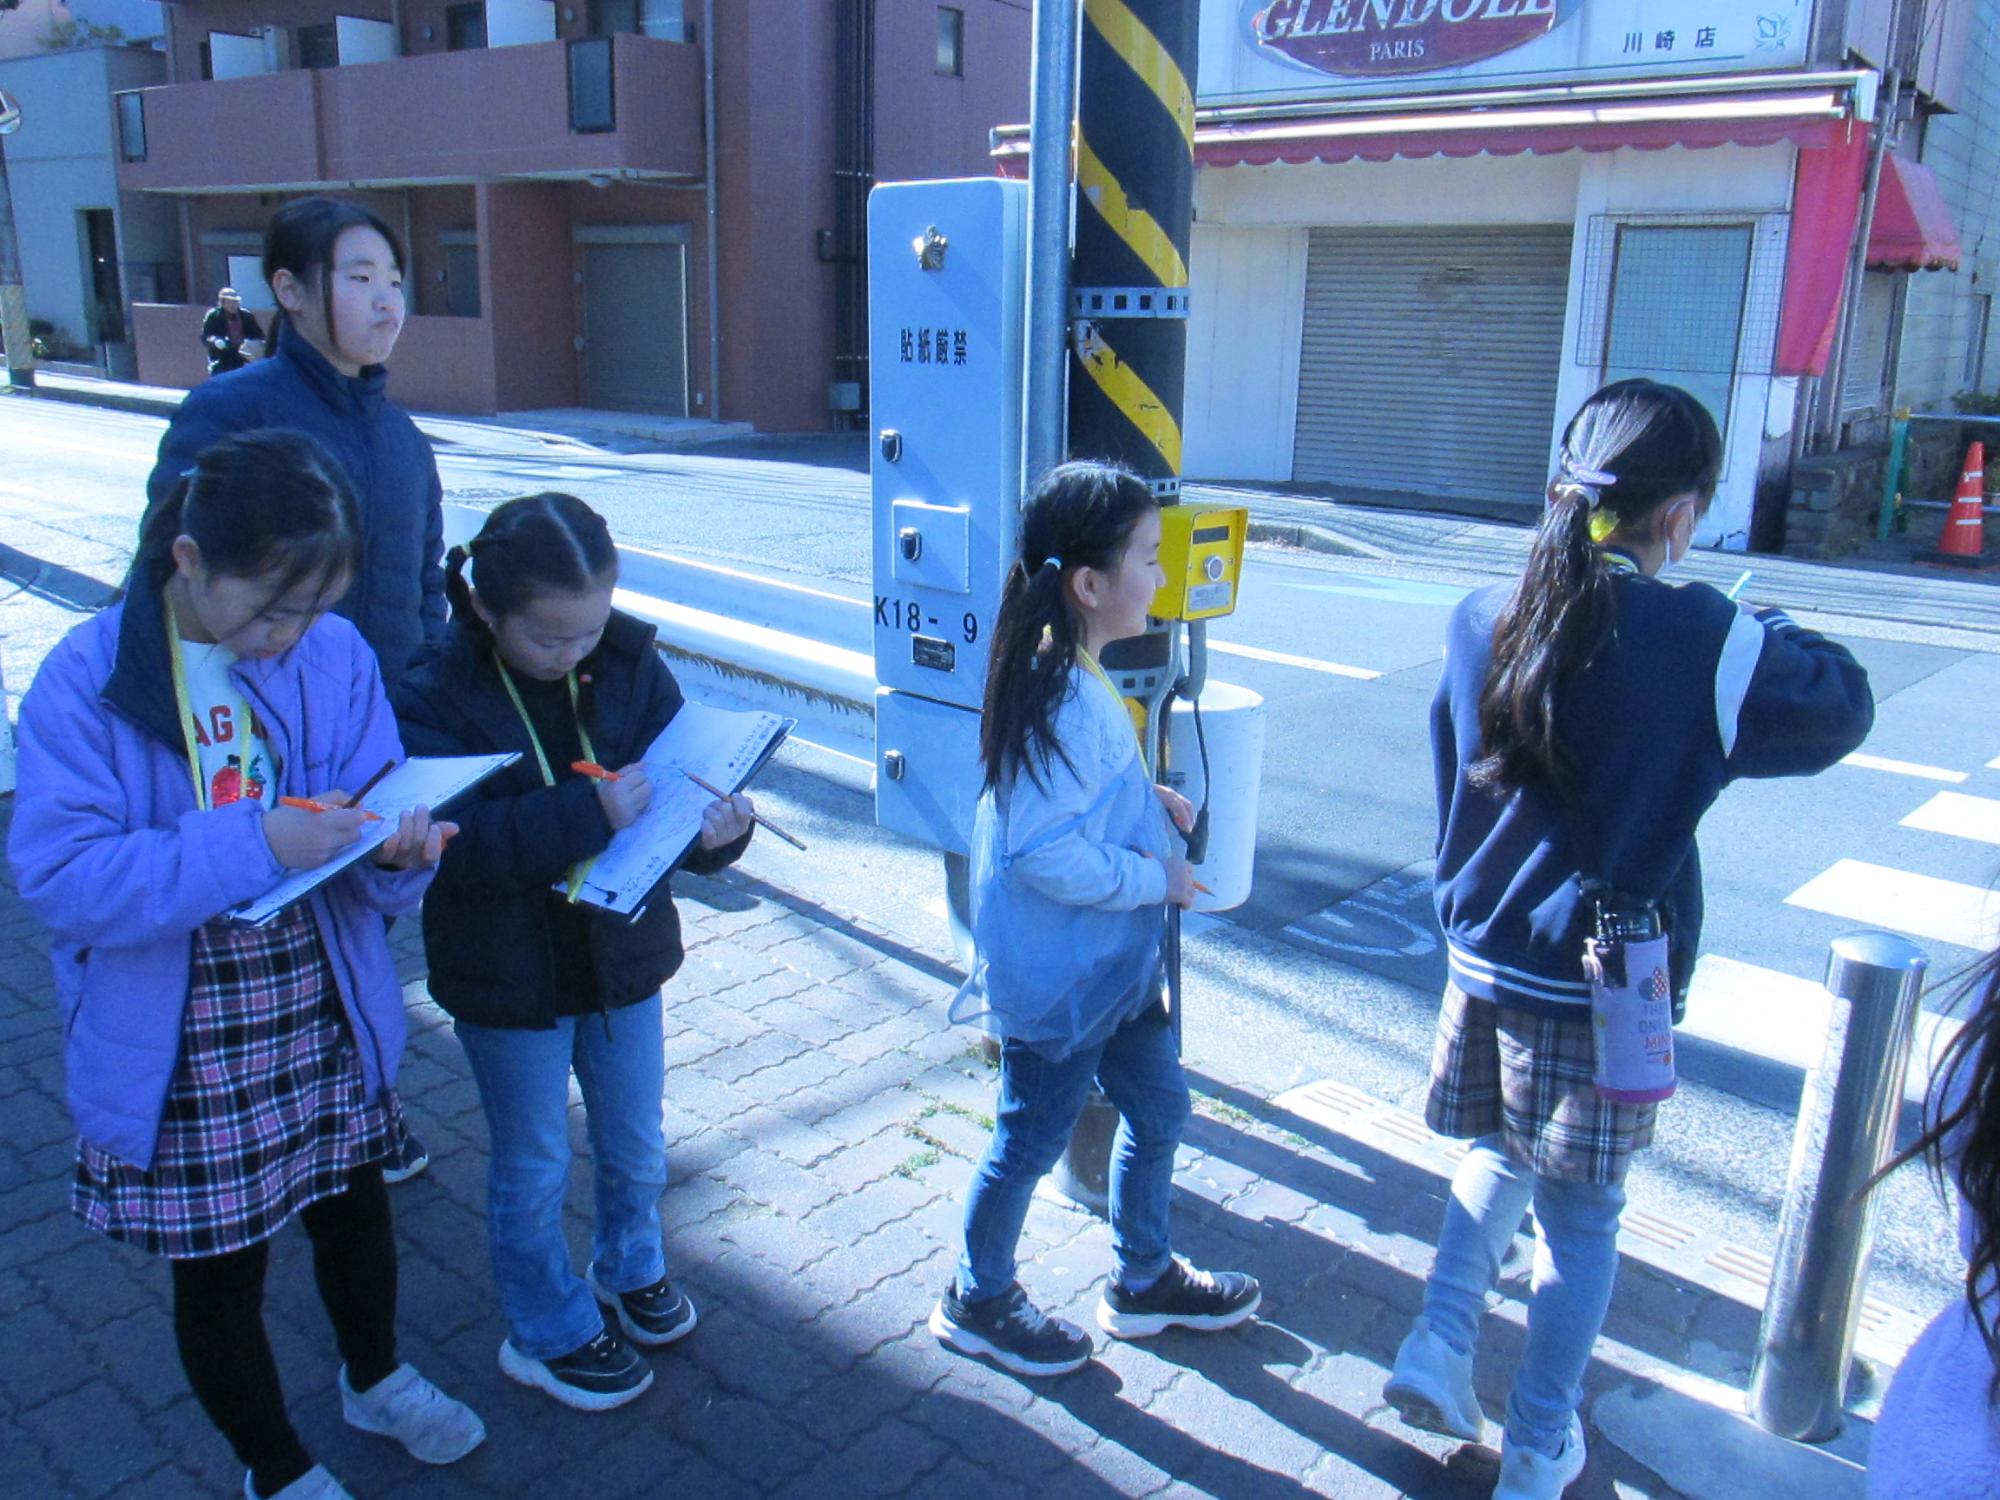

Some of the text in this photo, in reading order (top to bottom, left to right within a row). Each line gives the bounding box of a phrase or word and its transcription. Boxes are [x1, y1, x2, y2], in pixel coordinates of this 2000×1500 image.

[1370, 40, 1425, 60] PARIS
[1623, 26, 1717, 53] 川崎店
